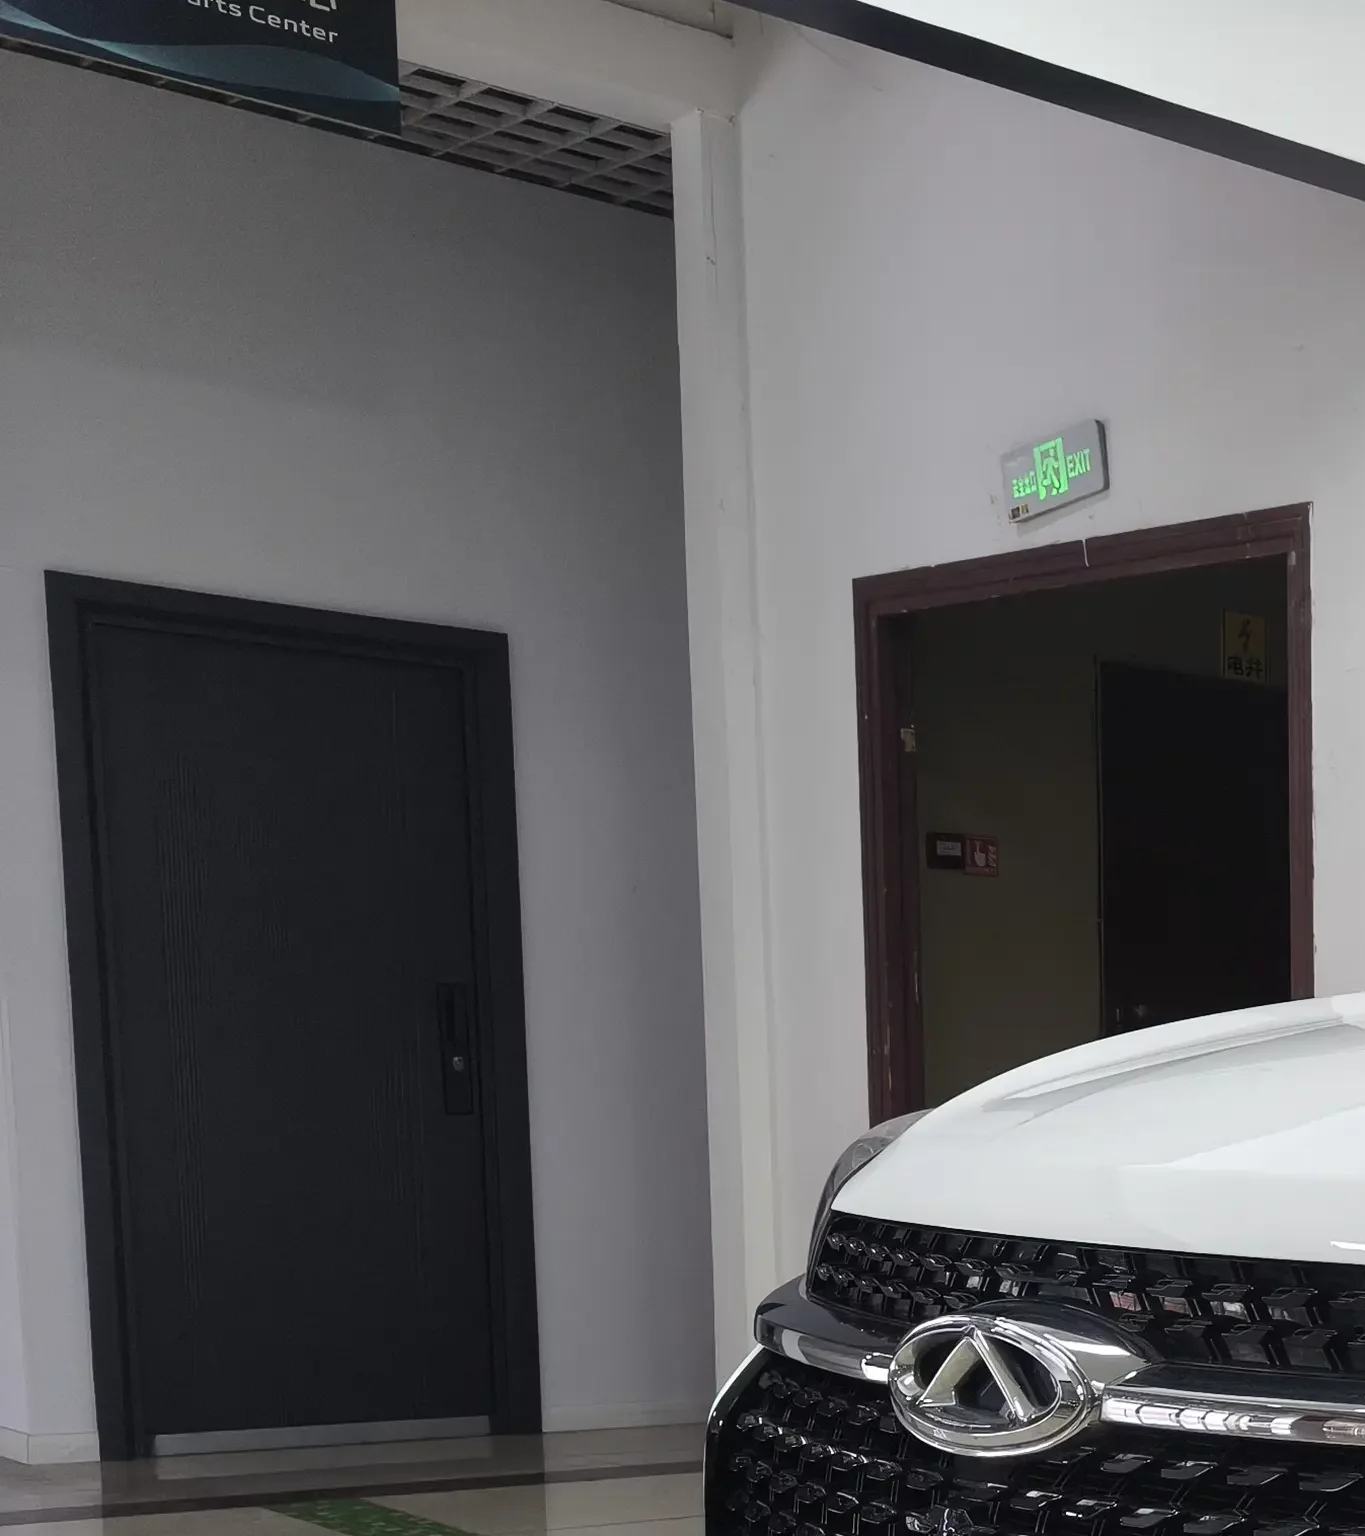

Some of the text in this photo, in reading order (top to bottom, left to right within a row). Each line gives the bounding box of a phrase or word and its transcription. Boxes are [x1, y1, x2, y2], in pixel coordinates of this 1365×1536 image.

[249, 5, 339, 43] Center
[1066, 448, 1091, 478] EXIT
[1228, 656, 1264, 680] 电井
